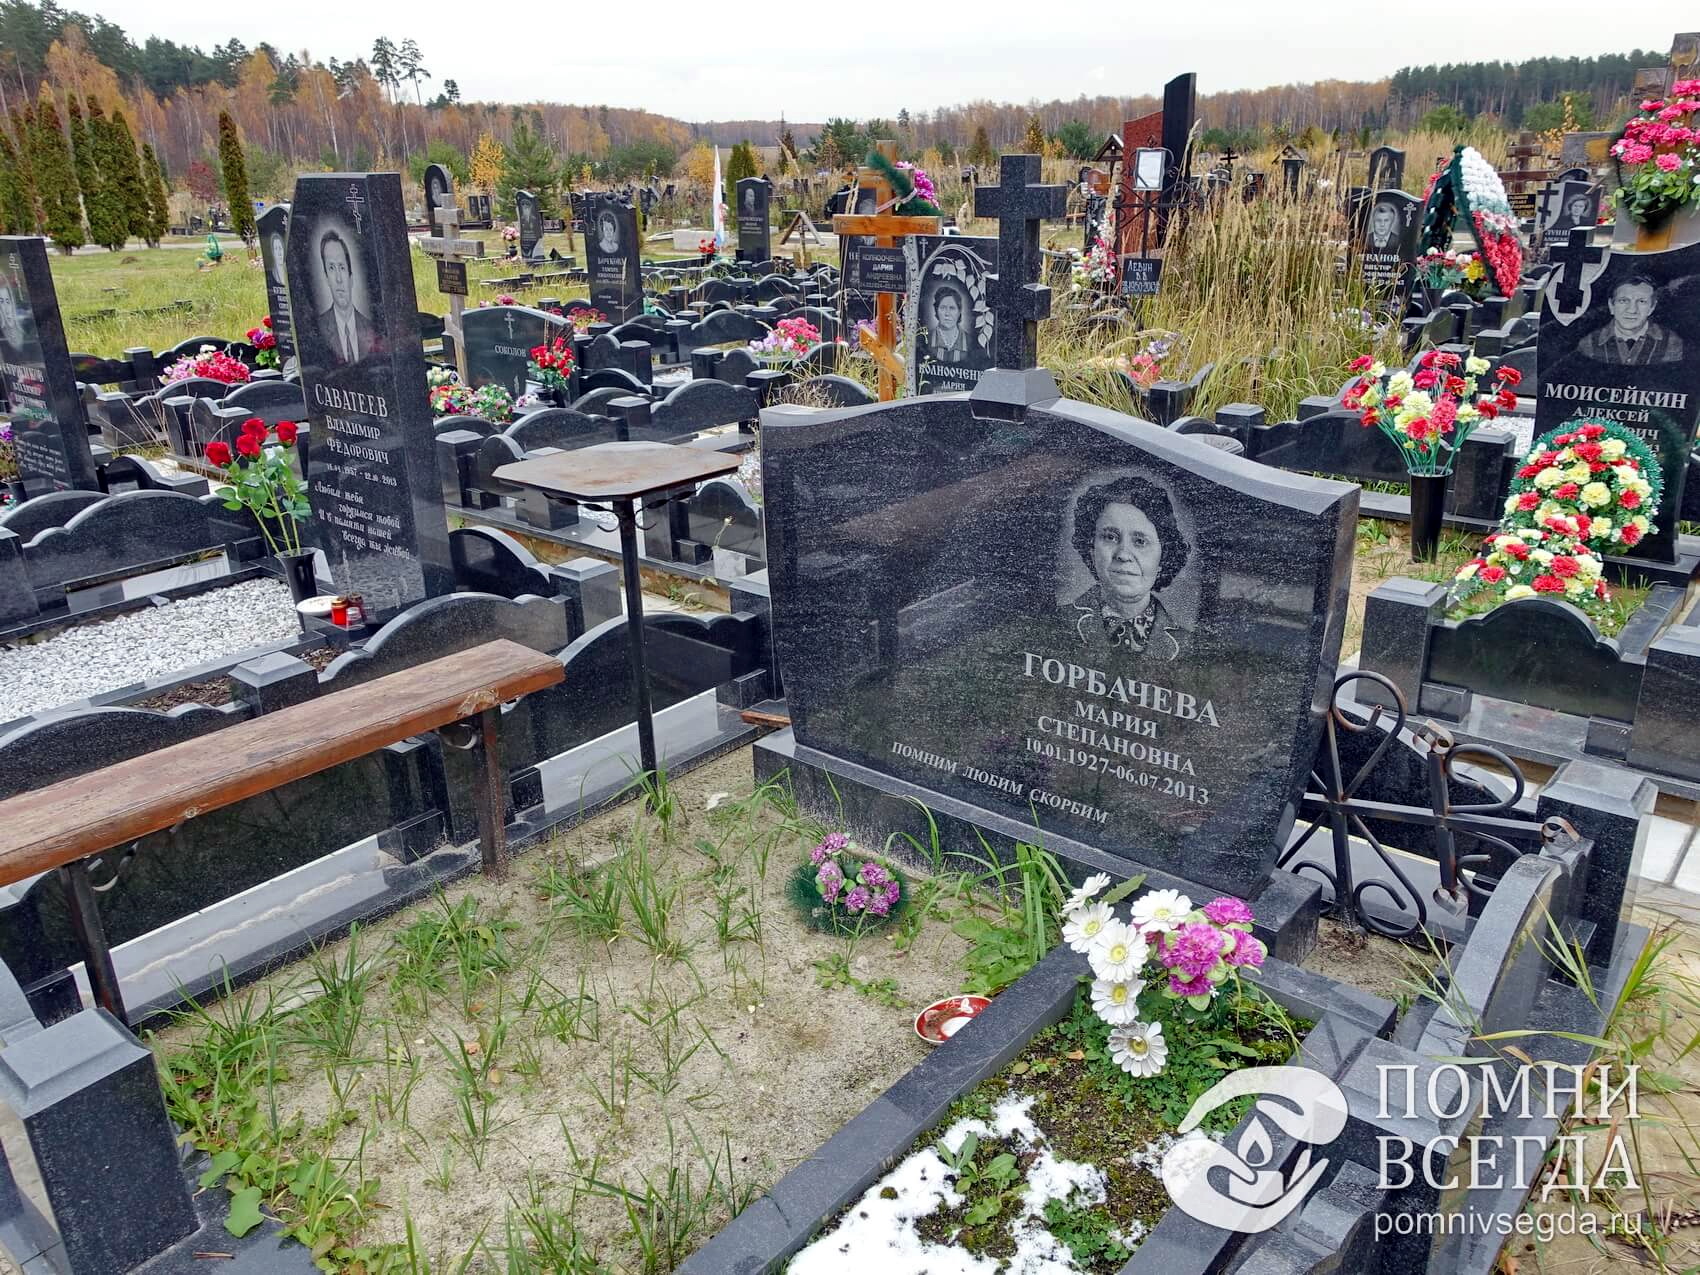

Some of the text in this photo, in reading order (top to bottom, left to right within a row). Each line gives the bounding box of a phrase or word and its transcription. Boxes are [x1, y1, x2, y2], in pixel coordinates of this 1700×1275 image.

[1127, 260, 1153, 272] ЛЕВИН
[494, 344, 527, 358] СОКОЛОВ
[315, 383, 388, 418] САВАТЕЕВ
[1544, 383, 1688, 409] МОИСЕЙКИН
[325, 414, 381, 441] ВЛАДИМИР
[1571, 406, 1650, 423] АЛЕКСЕЙ
[326, 437, 389, 465] ФЁДОРОВИЧ
[1022, 651, 1221, 727] ГОРБАЧЕВА
[1075, 700, 1159, 739] МАРИЯ
[1037, 715, 1197, 777] СТЕПАНОВНА
[892, 741, 1111, 824] ПОМНИМ ЛЮБИМ СКОРБИМ
